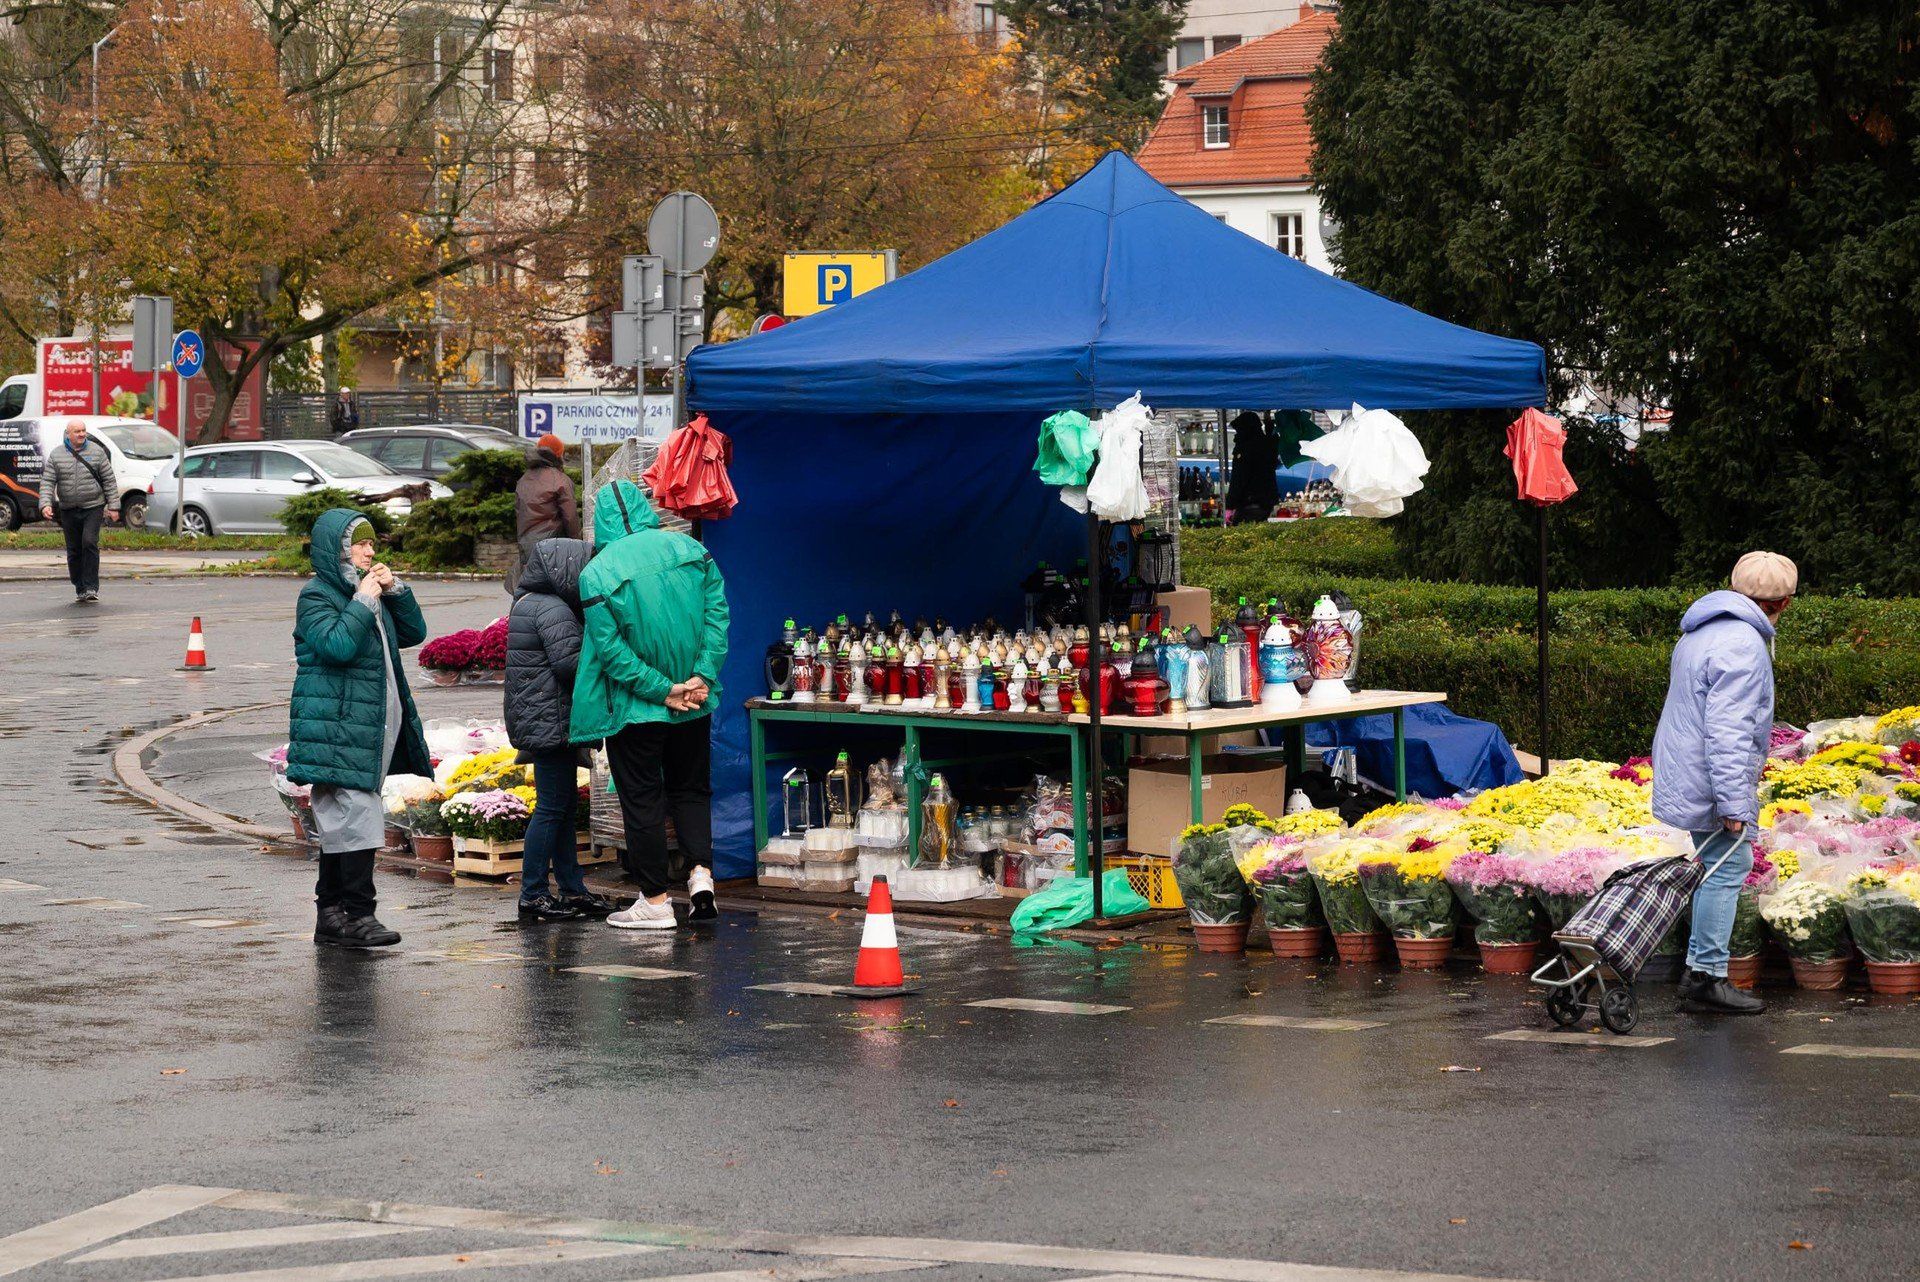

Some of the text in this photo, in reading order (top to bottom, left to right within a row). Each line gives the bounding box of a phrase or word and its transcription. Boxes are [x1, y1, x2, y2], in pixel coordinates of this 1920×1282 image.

[825, 269, 847, 301] P
[531, 409, 546, 433] P
[557, 405, 603, 418] PARKING
[651, 405, 662, 417] 24
[666, 405, 671, 416] h
[574, 424, 654, 440] 7 dni w tygodiu
